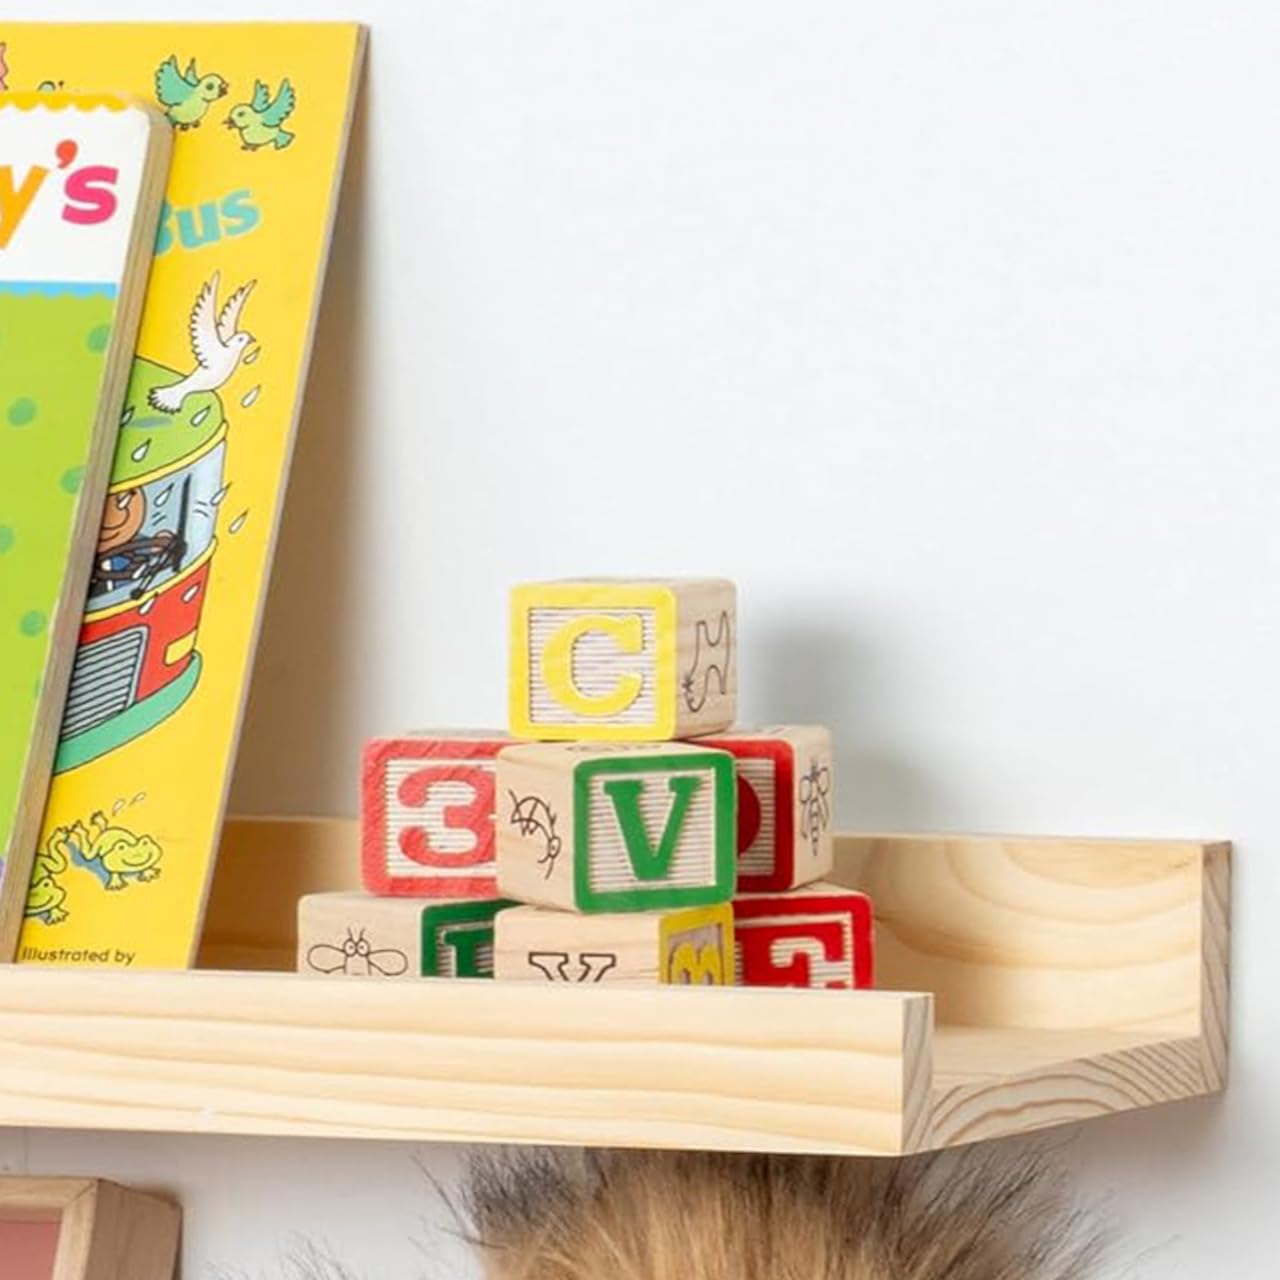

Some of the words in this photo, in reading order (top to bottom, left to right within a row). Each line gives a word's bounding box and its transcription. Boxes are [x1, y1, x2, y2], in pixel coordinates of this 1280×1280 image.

[541, 613, 644, 717] C
[397, 764, 497, 869] 3
[602, 774, 705, 882] V
[22, 946, 110, 963] Illustrated
[114, 949, 136, 967] by
